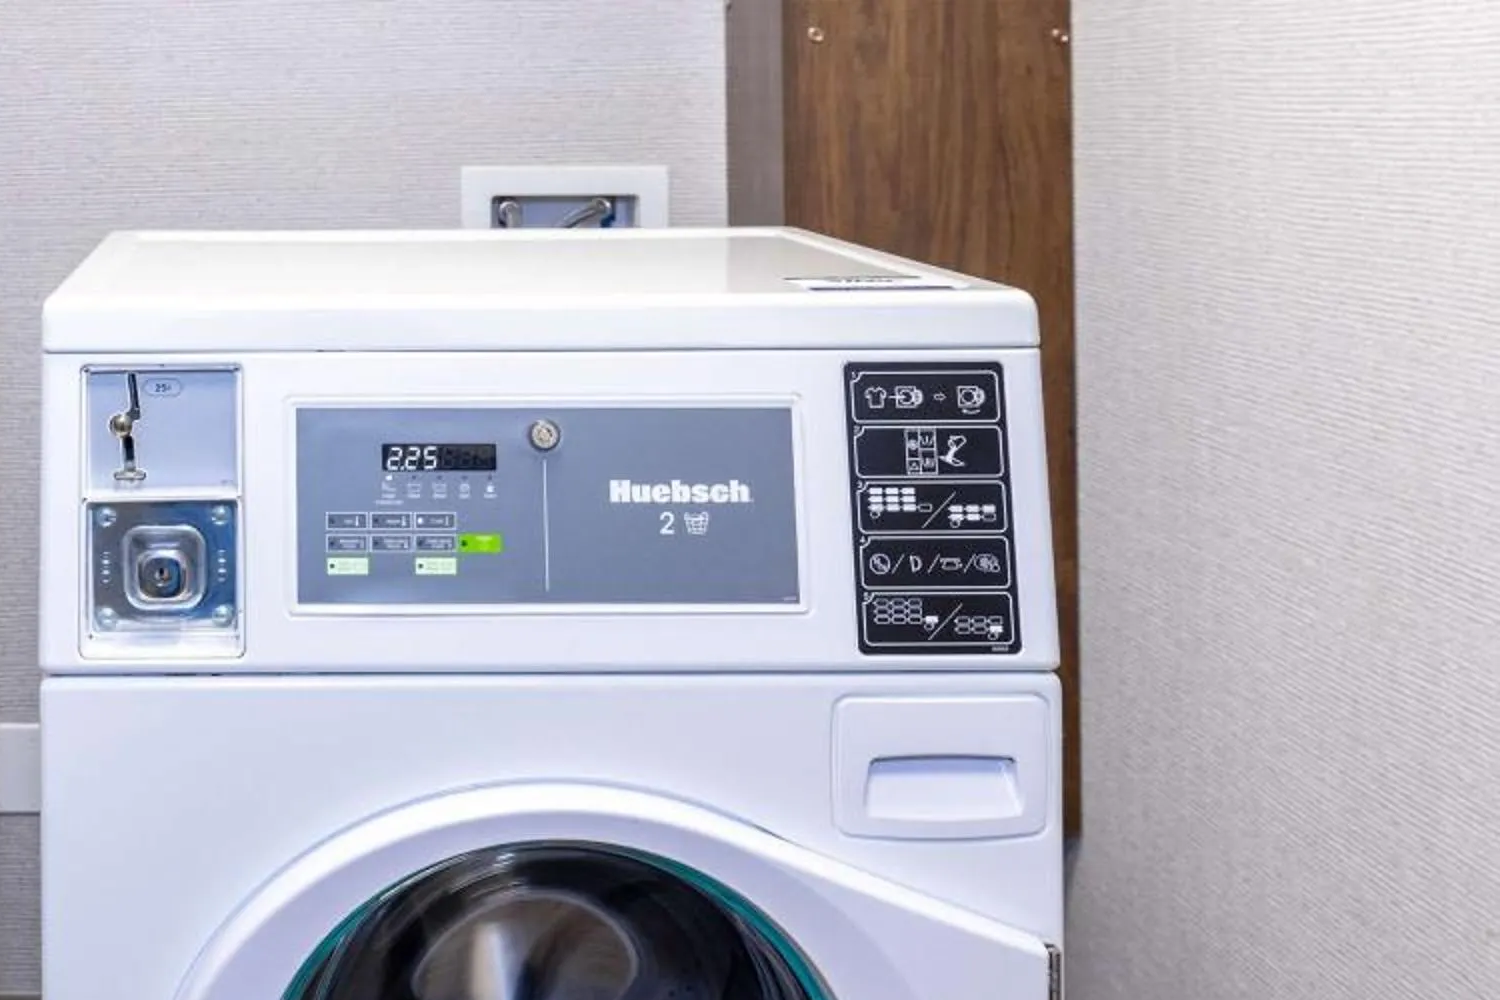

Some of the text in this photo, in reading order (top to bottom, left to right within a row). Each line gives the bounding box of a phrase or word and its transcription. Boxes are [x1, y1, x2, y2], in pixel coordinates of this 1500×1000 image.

[387, 446, 437, 471] 2.25
[609, 479, 750, 503] Huebsch
[659, 511, 675, 535] 2
